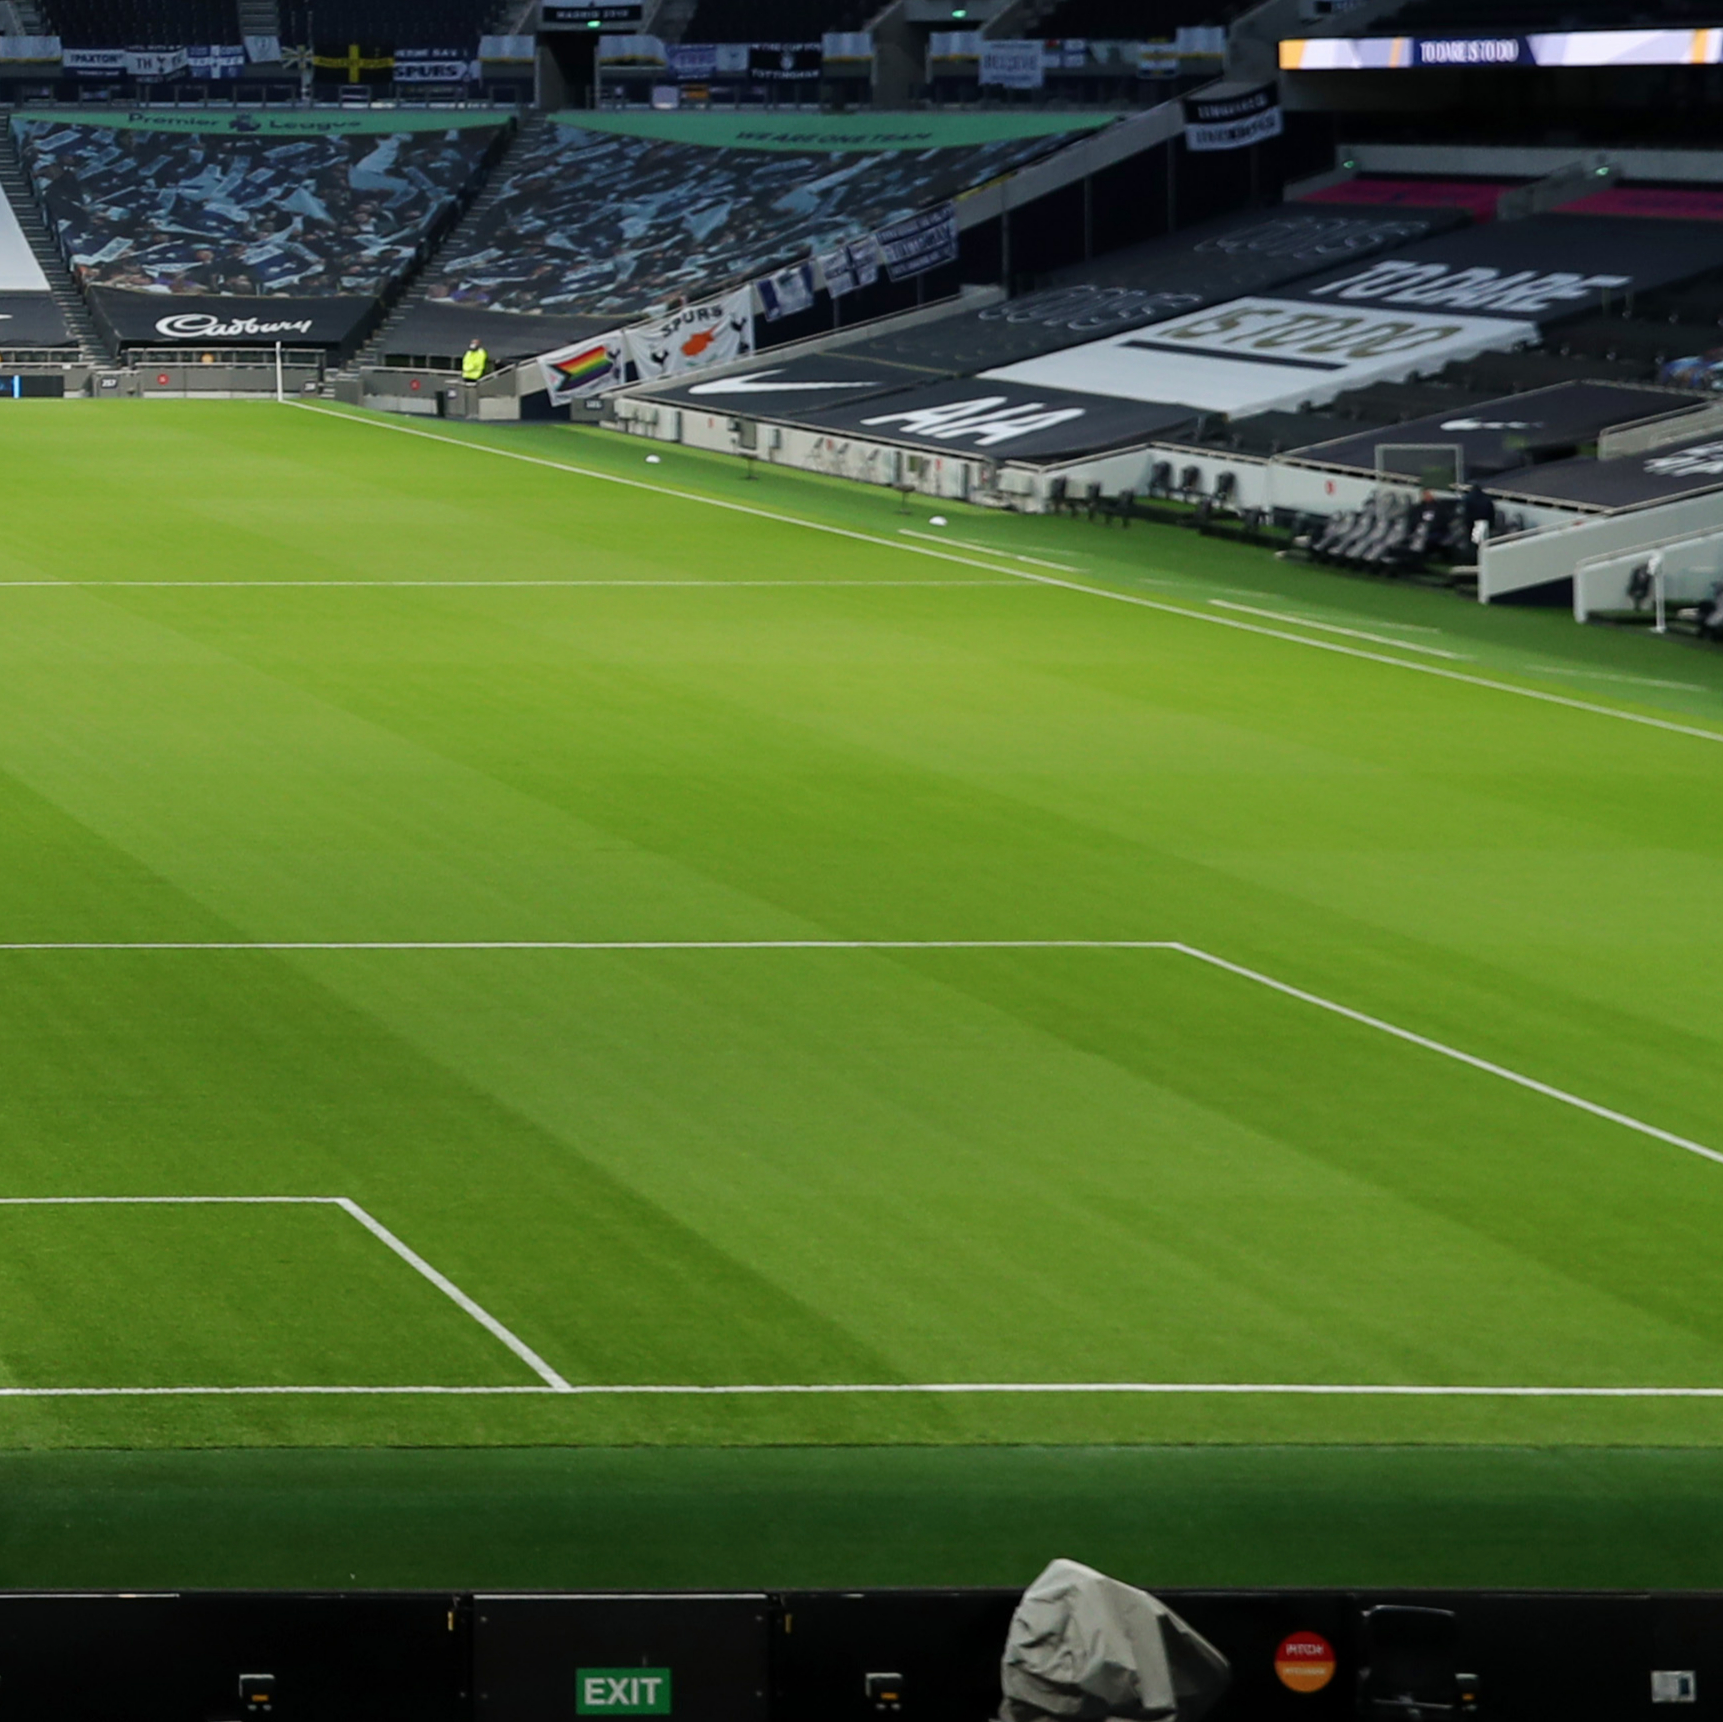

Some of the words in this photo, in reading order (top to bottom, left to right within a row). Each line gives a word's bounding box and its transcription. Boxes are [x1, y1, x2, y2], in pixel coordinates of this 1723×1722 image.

[394, 64, 457, 77] SPURS
[128, 112, 219, 128] Premier
[269, 117, 362, 131] League
[1308, 259, 1450, 299] TO
[1380, 266, 1634, 312] DARE
[155, 312, 313, 338] Cadbury
[661, 303, 724, 338] SPURS
[860, 395, 1087, 447] AIA
[1286, 1643, 1324, 1656] PITCH
[584, 1677, 663, 1706] EXIT
